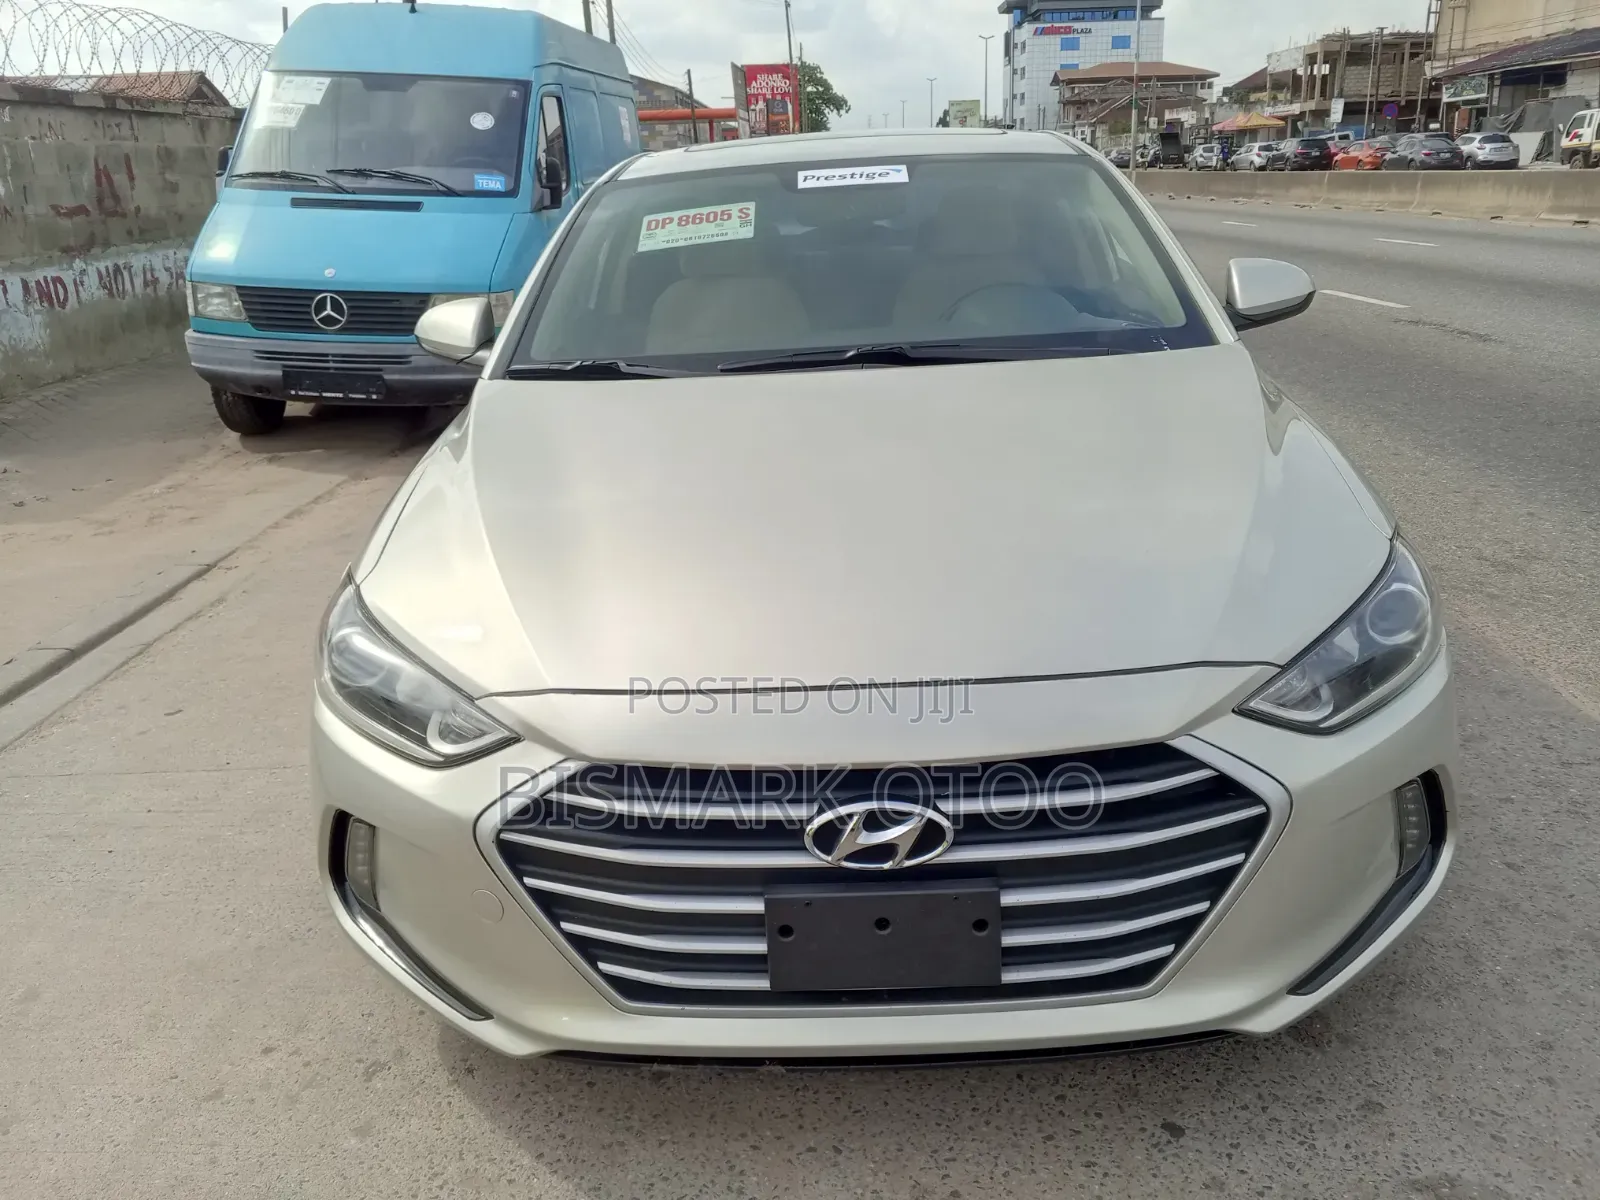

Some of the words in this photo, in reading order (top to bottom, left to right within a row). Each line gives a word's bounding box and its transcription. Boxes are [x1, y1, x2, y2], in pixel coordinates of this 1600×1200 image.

[751, 80, 790, 88] ADONKO
[802, 171, 890, 183] Prestige
[478, 179, 501, 189] TEMA
[646, 216, 675, 232] DP
[676, 209, 733, 228] 8605
[737, 207, 751, 220] S
